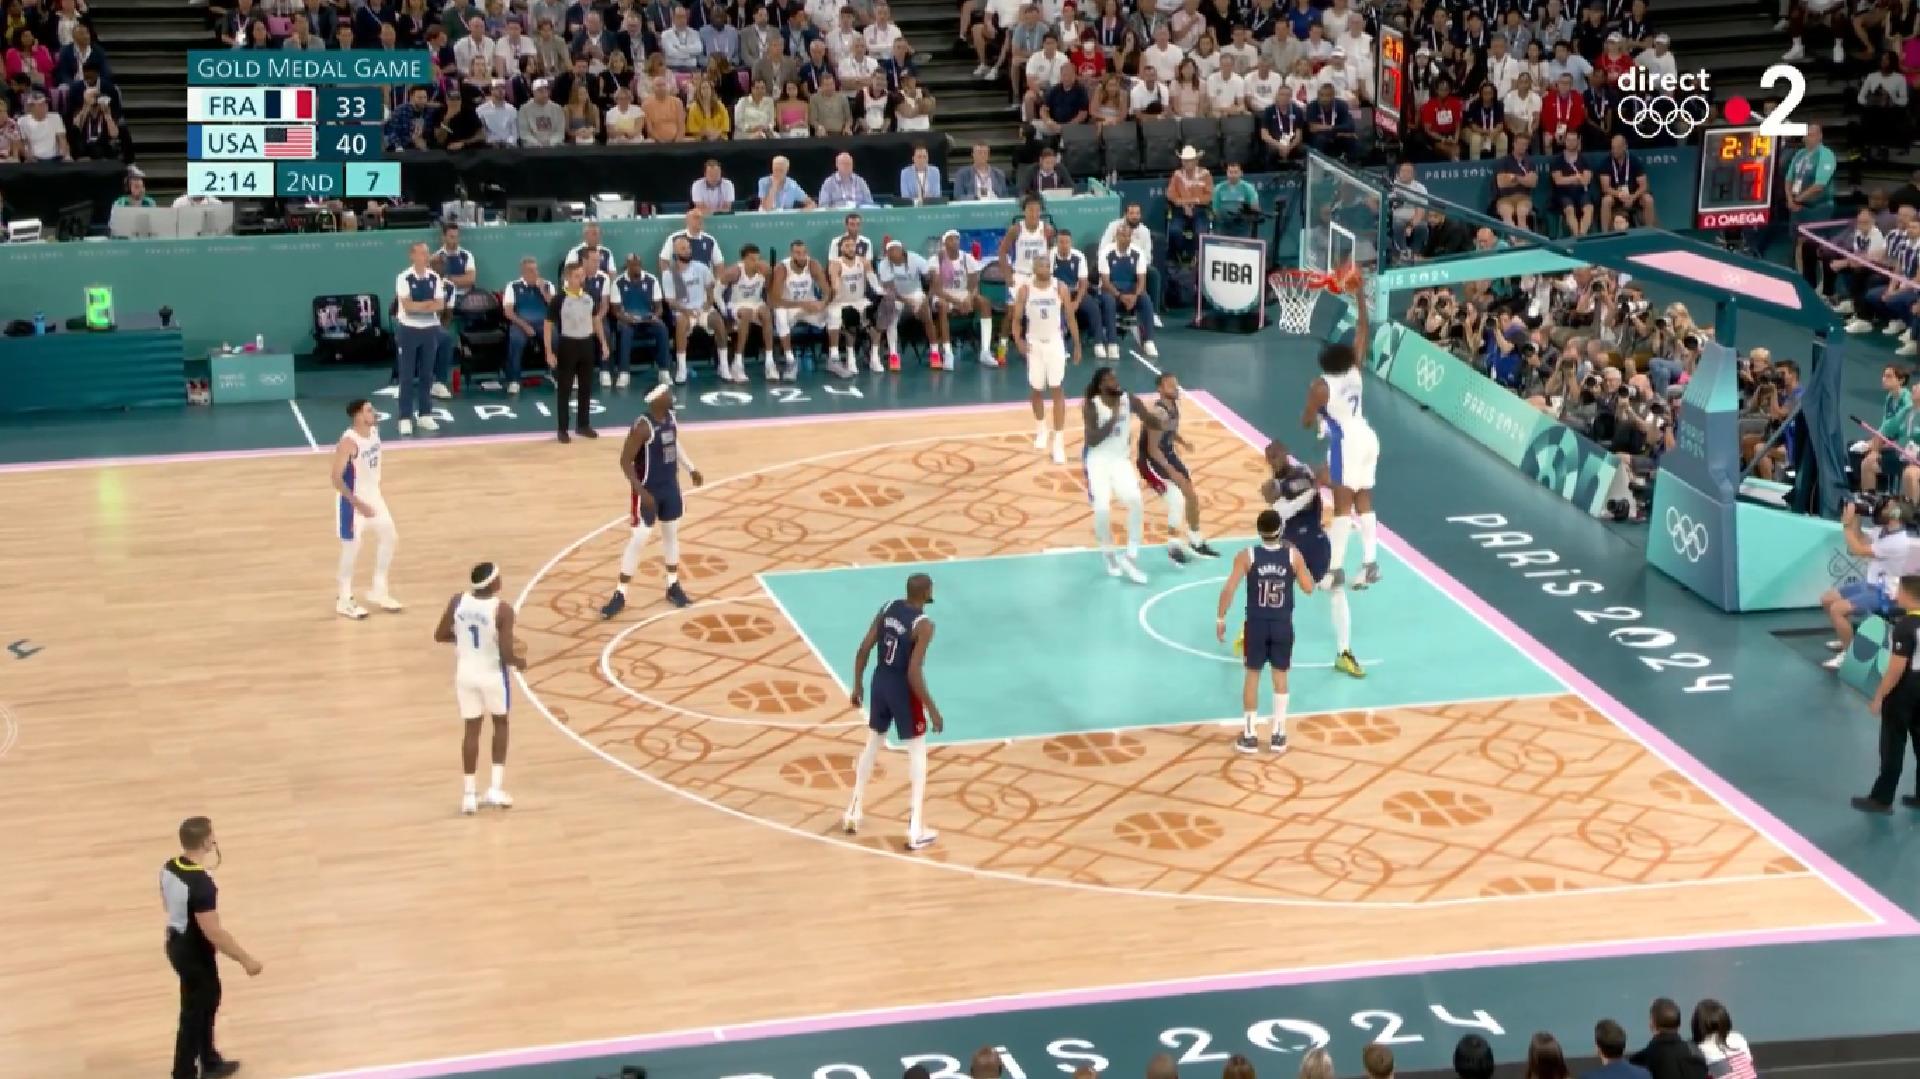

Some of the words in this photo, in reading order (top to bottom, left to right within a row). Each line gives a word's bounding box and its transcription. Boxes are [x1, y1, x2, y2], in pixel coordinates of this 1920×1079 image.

[1721, 135, 1771, 159] 2:14
[1740, 161, 1766, 200] 7
[1718, 213, 1766, 225] OMEGA
[1211, 260, 1253, 285] FIBA
[87, 287, 112, 327] 2
[1347, 394, 1359, 417] 7
[1257, 579, 1286, 608] 15
[468, 624, 480, 649] 1
[884, 631, 899, 666] 7
[1573, 605, 1735, 694] 2024
[1158, 1004, 1507, 1064] 2024
